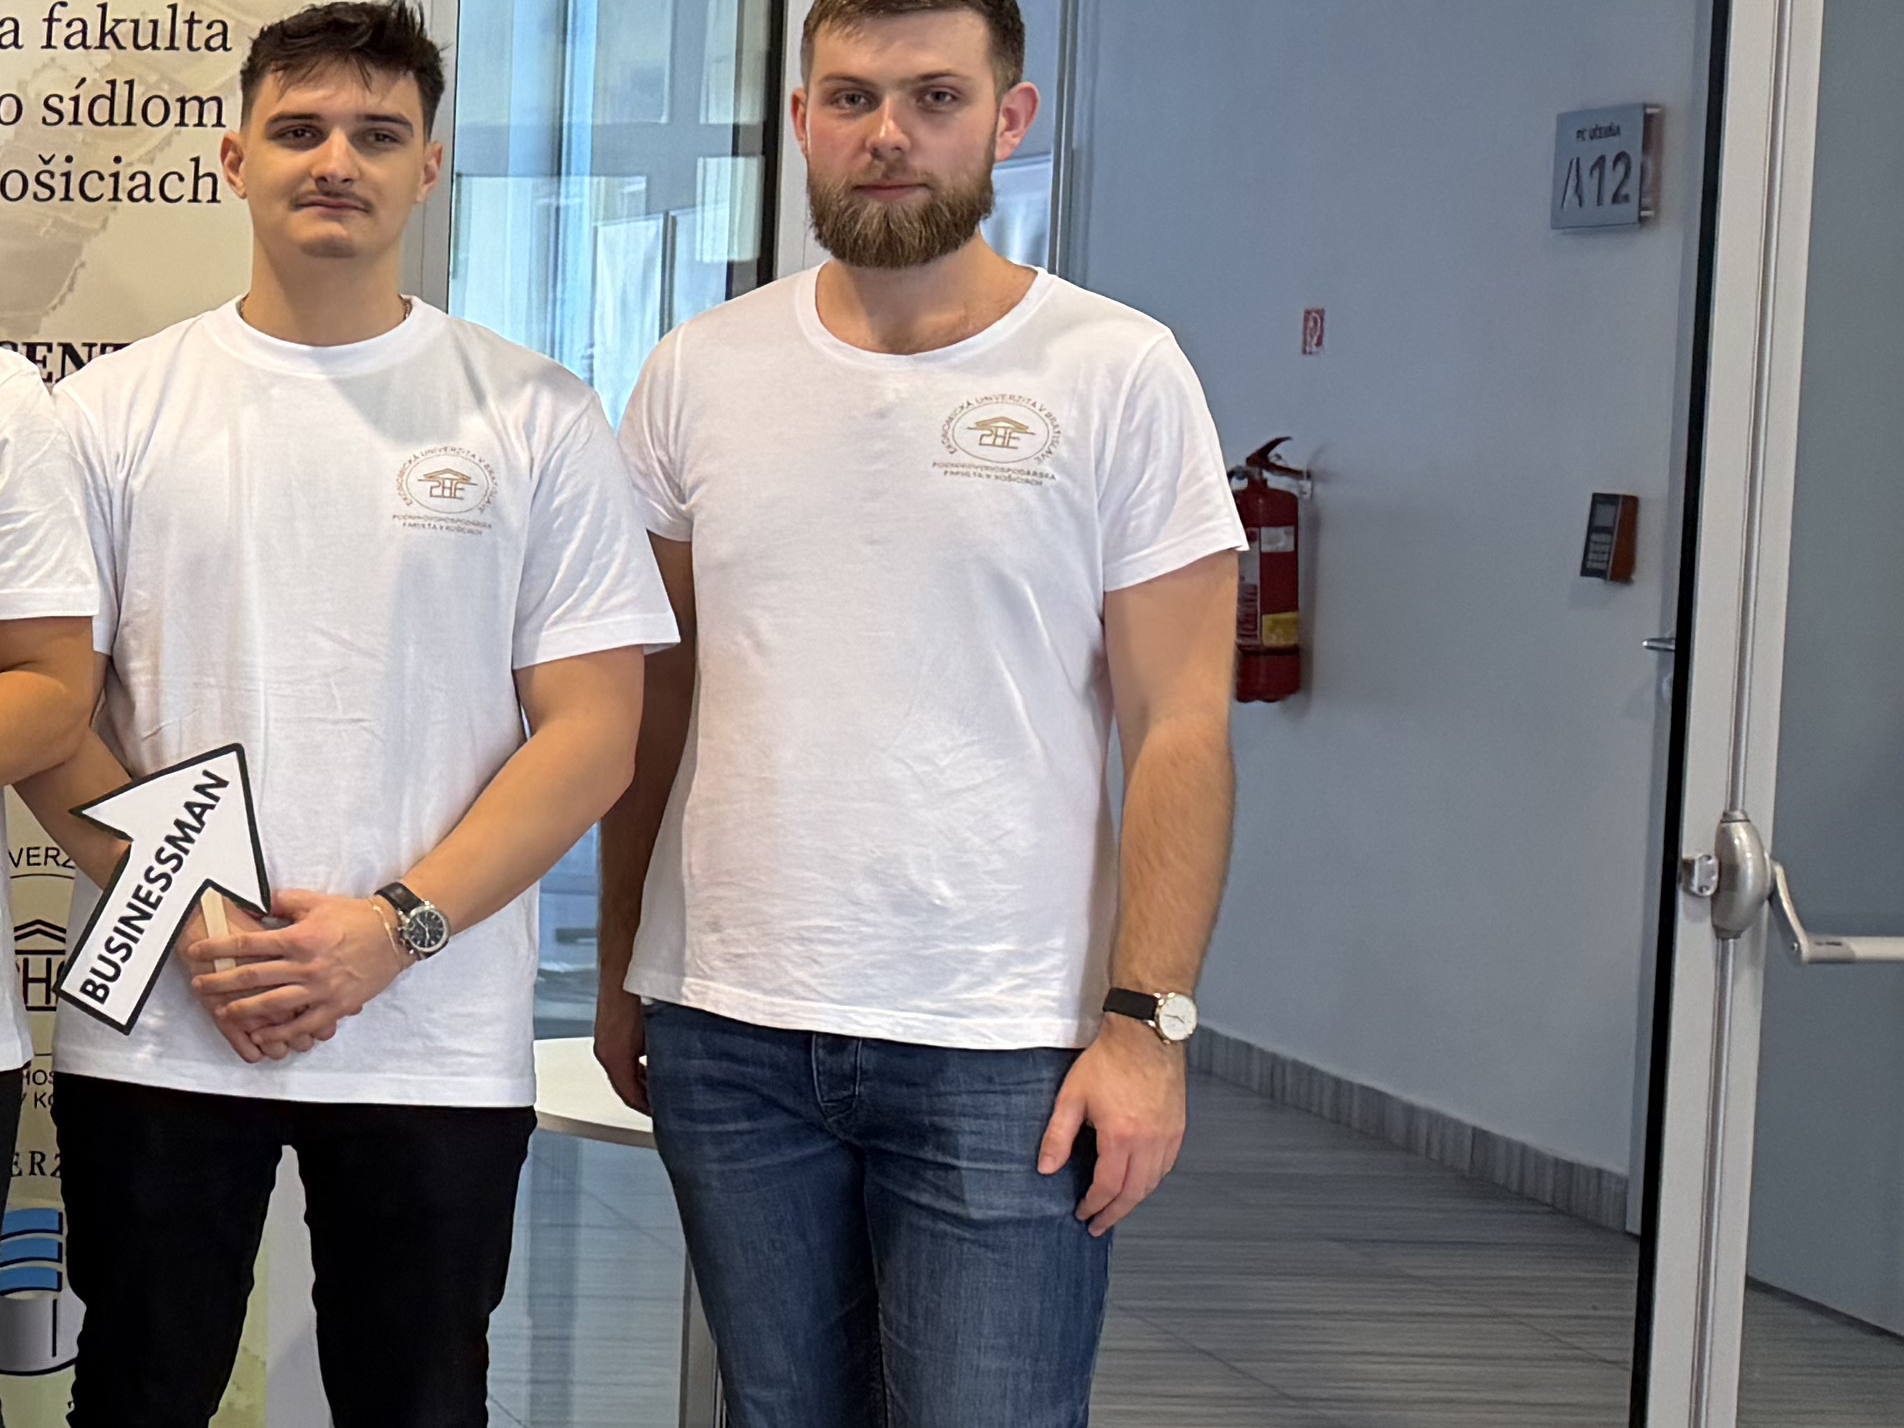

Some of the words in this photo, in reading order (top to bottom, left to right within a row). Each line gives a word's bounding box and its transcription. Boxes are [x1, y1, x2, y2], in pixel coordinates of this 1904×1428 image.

[40, 2, 232, 54] fakulta
[41, 78, 226, 131] sídlom
[79, 769, 230, 1005] BUSINESSMAN
